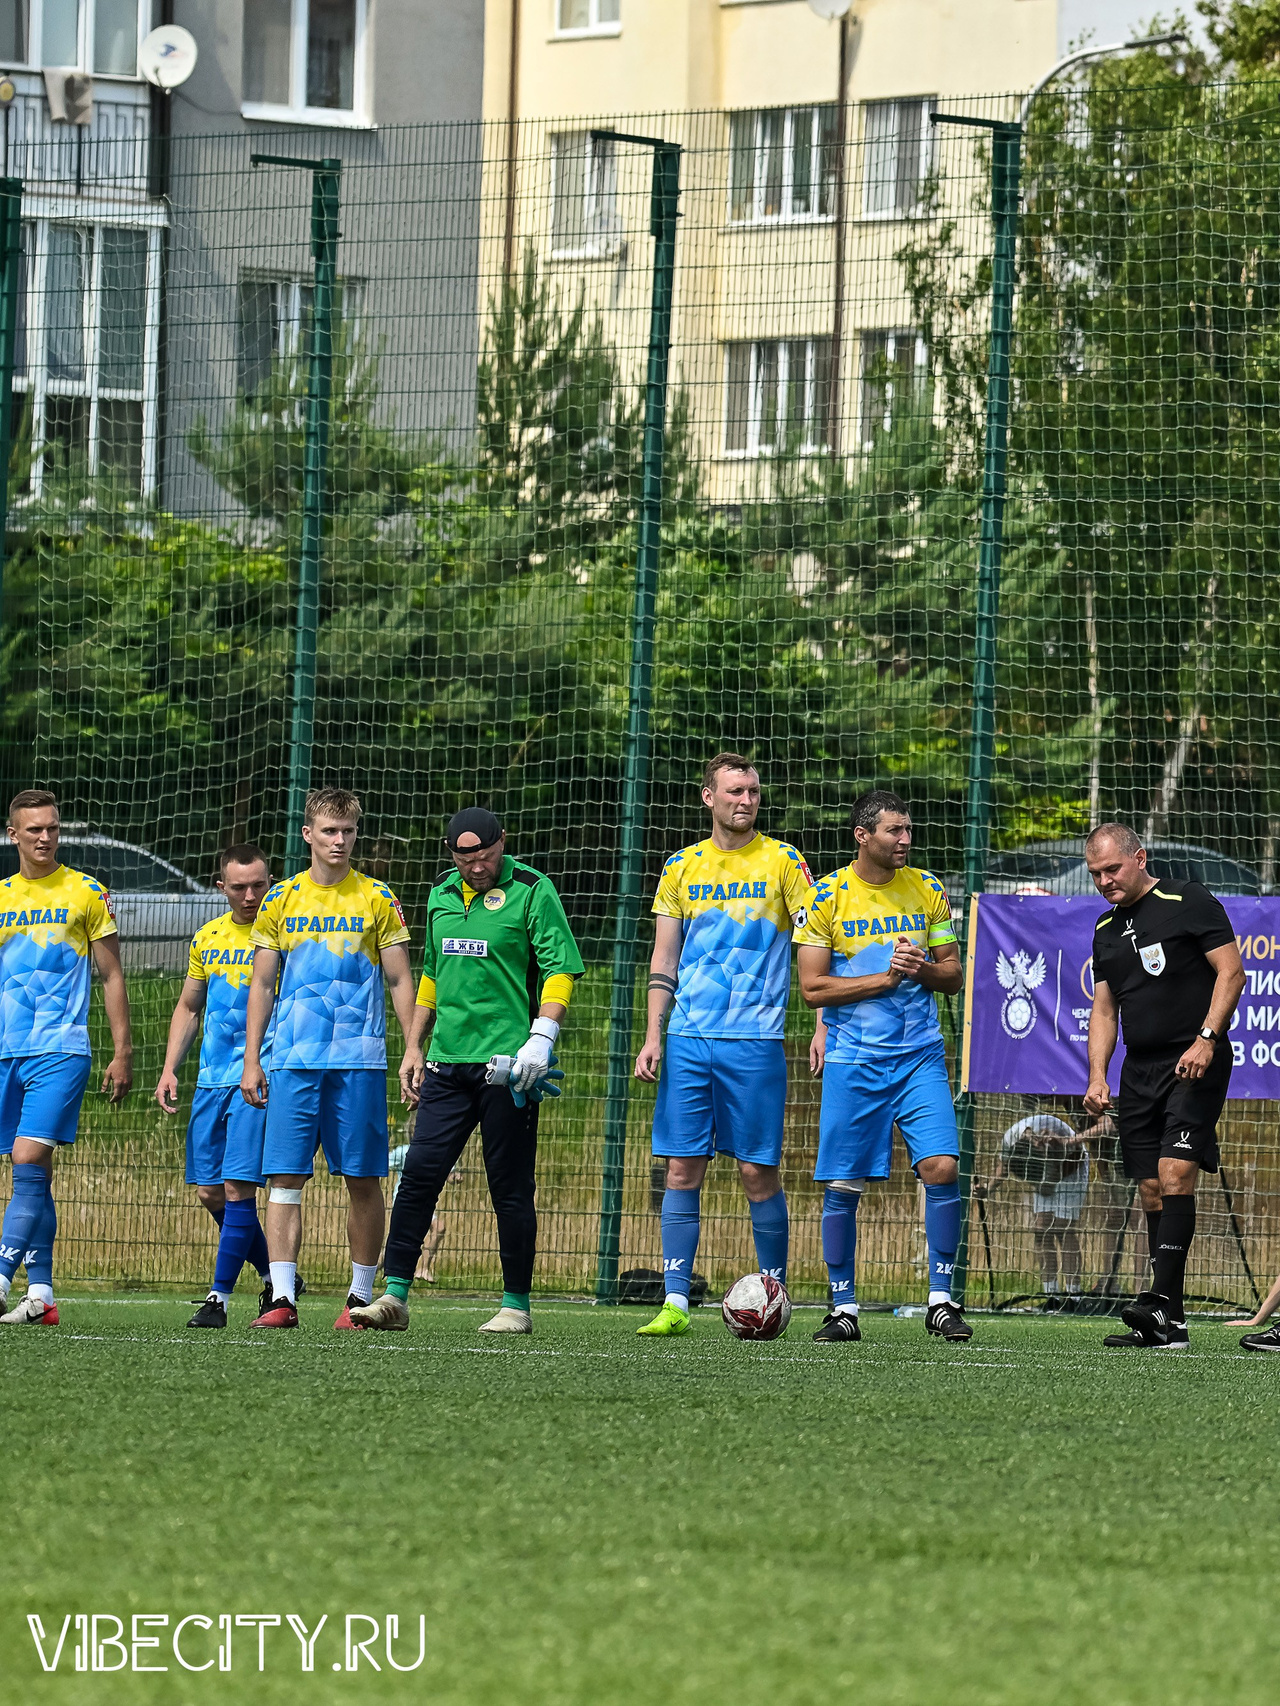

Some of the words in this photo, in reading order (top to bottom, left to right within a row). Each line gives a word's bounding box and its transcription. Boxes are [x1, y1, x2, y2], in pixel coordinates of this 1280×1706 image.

[688, 881, 767, 901] УРАЛАН
[286, 916, 365, 933] УРАЛАН
[842, 914, 926, 937] УРАЛАН
[458, 943, 485, 952] ЖБИ
[936, 1262, 954, 1274] 2K
[831, 1280, 850, 1292] 2K
